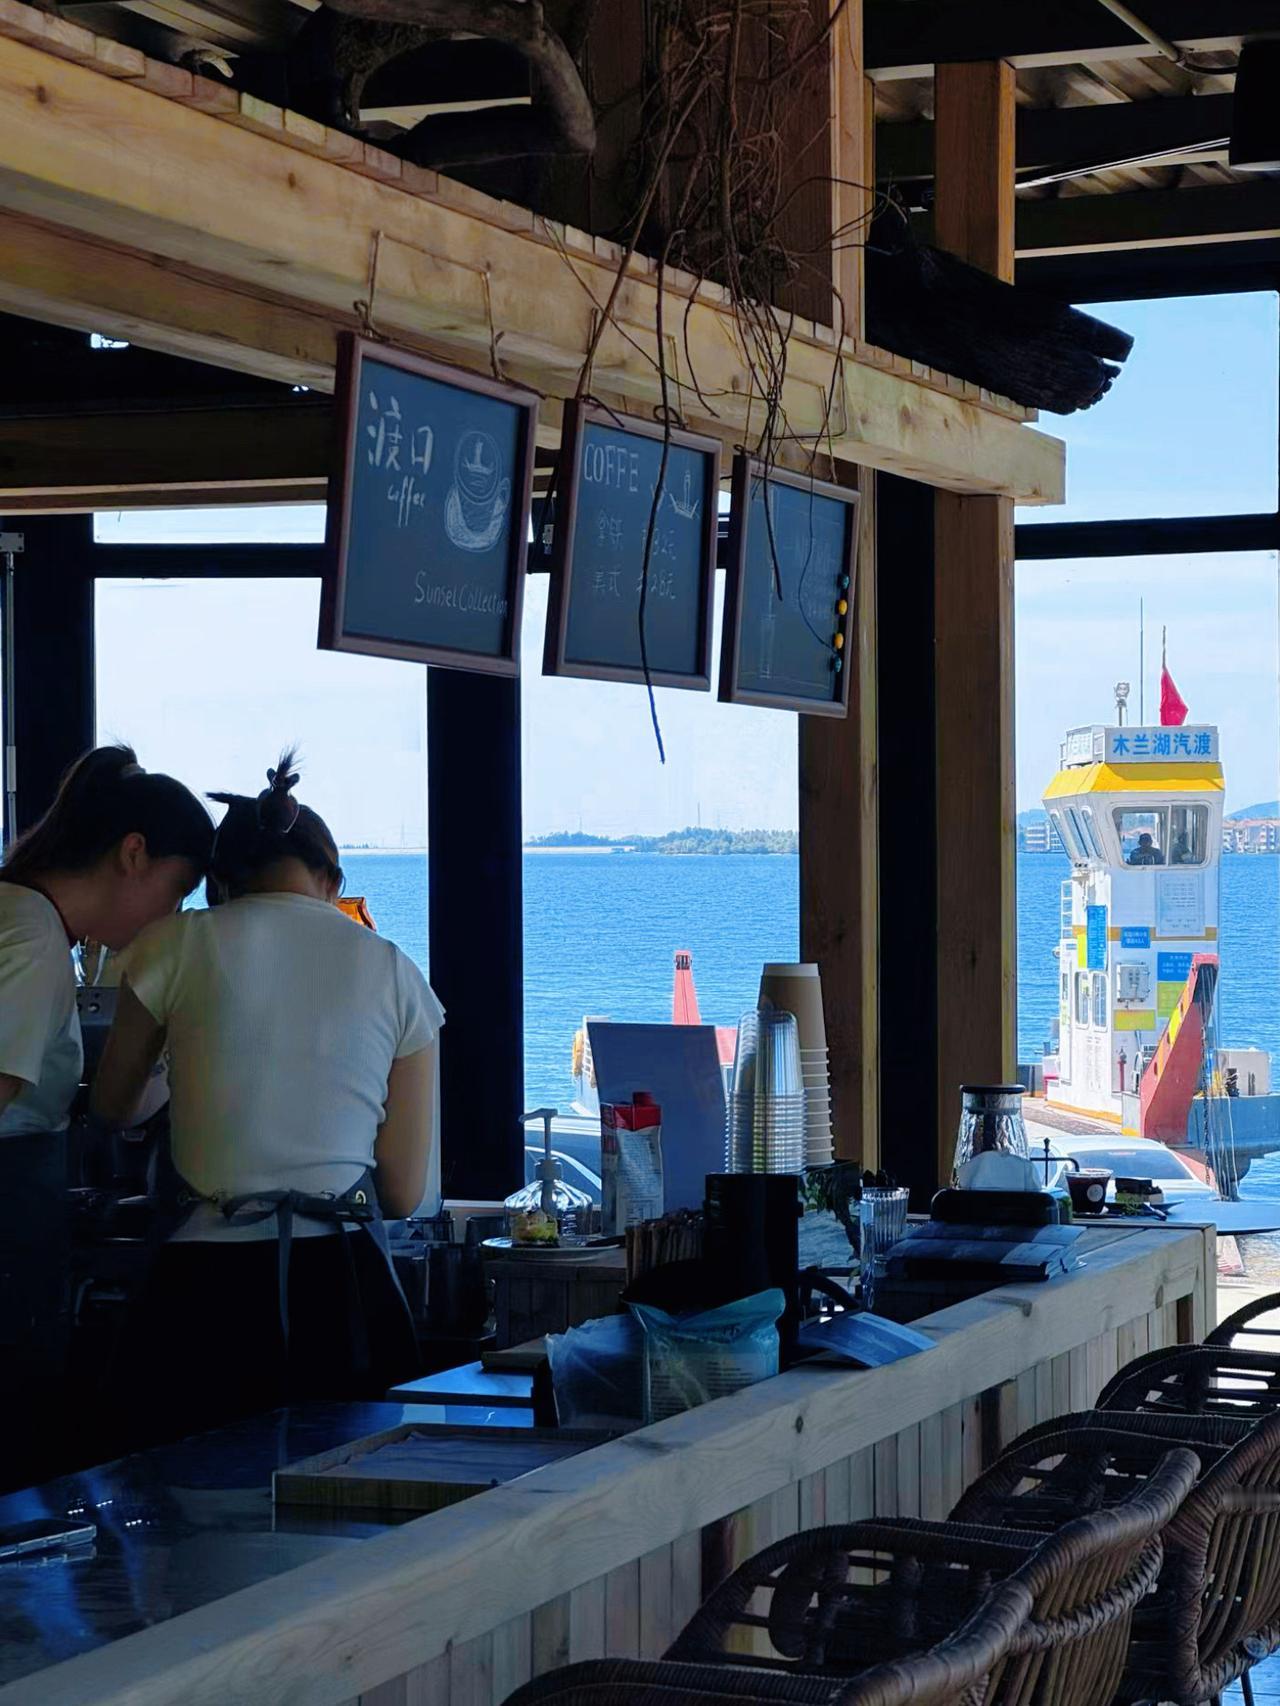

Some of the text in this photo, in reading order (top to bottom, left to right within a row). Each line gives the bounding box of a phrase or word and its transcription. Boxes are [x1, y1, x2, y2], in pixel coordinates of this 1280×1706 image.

[366, 388, 433, 475] 渡口
[584, 443, 640, 492] COFFE
[414, 569, 457, 609] Sunset
[1112, 732, 1212, 756] 木兰湖汽渡
